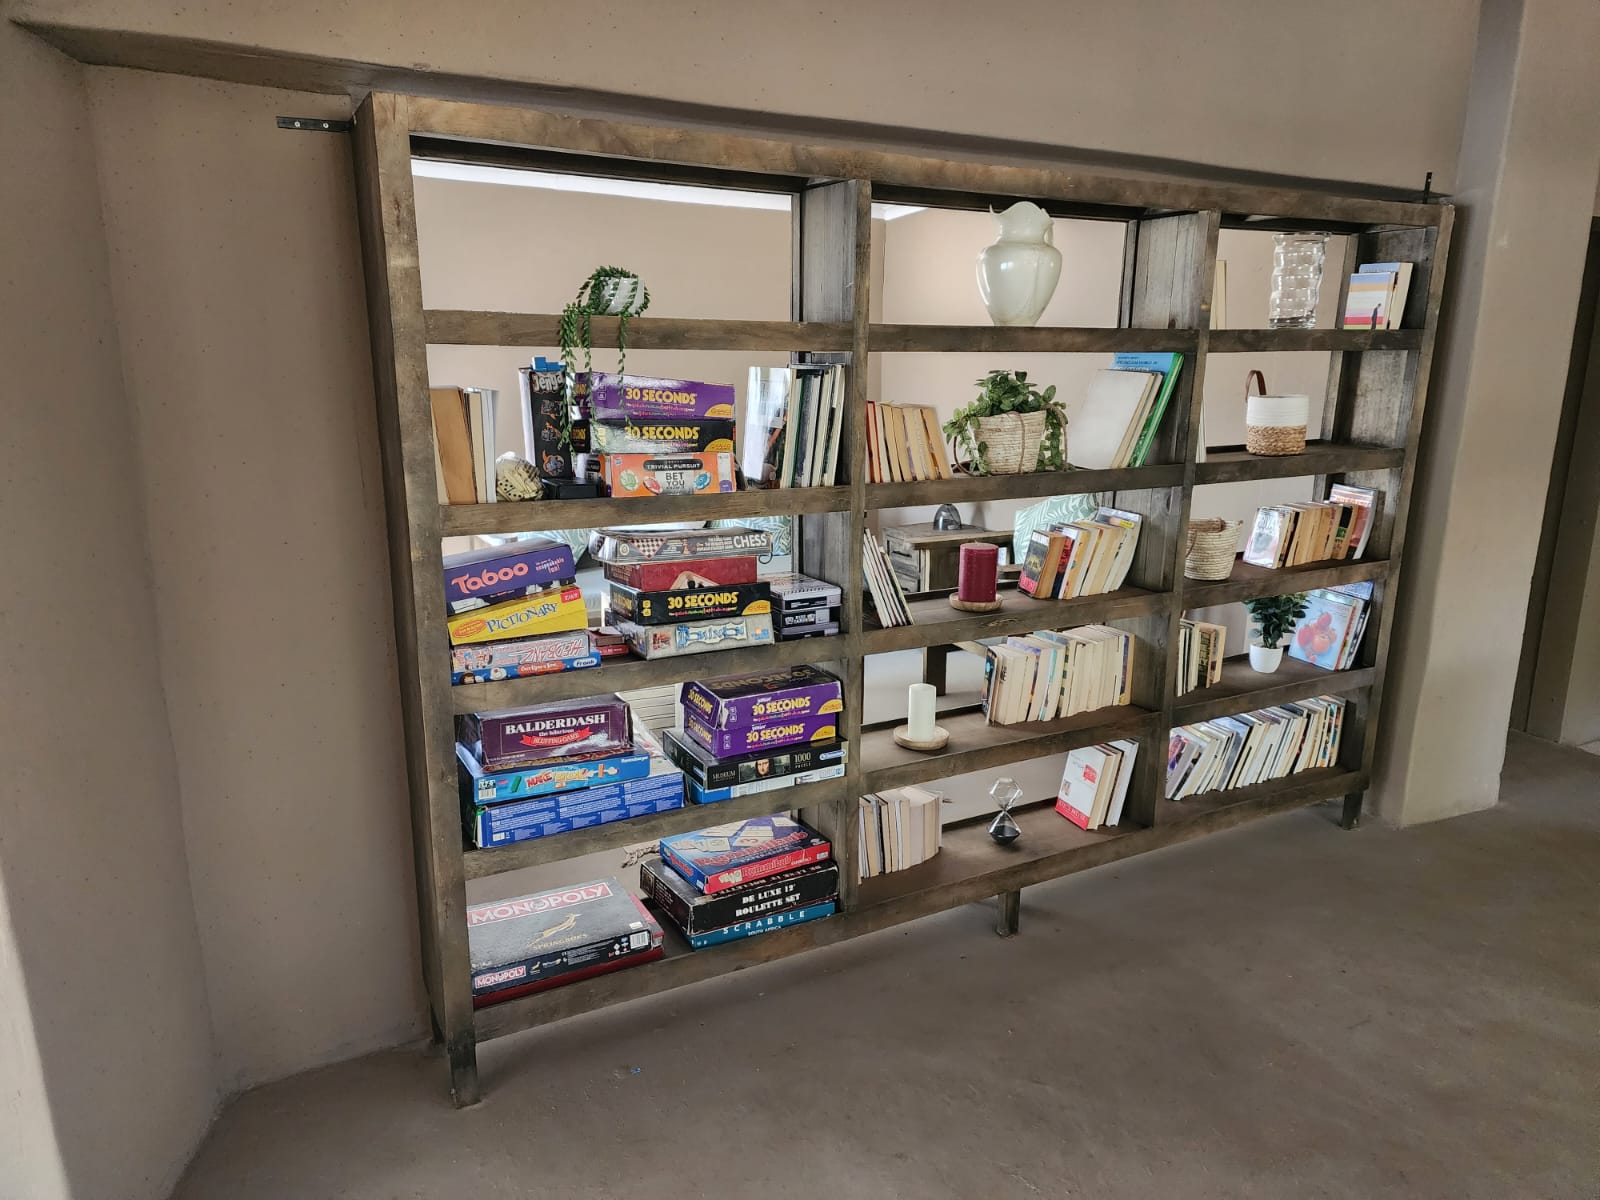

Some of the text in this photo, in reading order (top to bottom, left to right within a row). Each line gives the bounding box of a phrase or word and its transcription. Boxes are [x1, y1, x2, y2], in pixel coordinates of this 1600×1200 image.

[625, 388, 697, 405] 30 SECONDS
[625, 426, 700, 440] 30 SECONDS
[665, 472, 684, 480] BET
[666, 480, 685, 488] YOU
[733, 534, 767, 549] CHESS
[451, 562, 529, 594] Taboo
[668, 592, 739, 609] 30 SECONDS
[486, 602, 558, 633] PICTIONARY
[752, 704, 765, 716] 30
[766, 696, 811, 714] SECONDS
[505, 714, 606, 735] BALDERDASH
[746, 731, 759, 743] 30
[760, 723, 805, 741] SECONDS
[794, 752, 811, 764] 1000
[471, 883, 605, 924] MONOPOLY
[742, 894, 755, 904] DE
[758, 887, 782, 900] LUXE
[735, 893, 800, 917] ROULETTE SET
[723, 910, 805, 935] SCRABBLE
[765, 925, 782, 933] AFRICA
[477, 967, 524, 987] MONOPOLY
